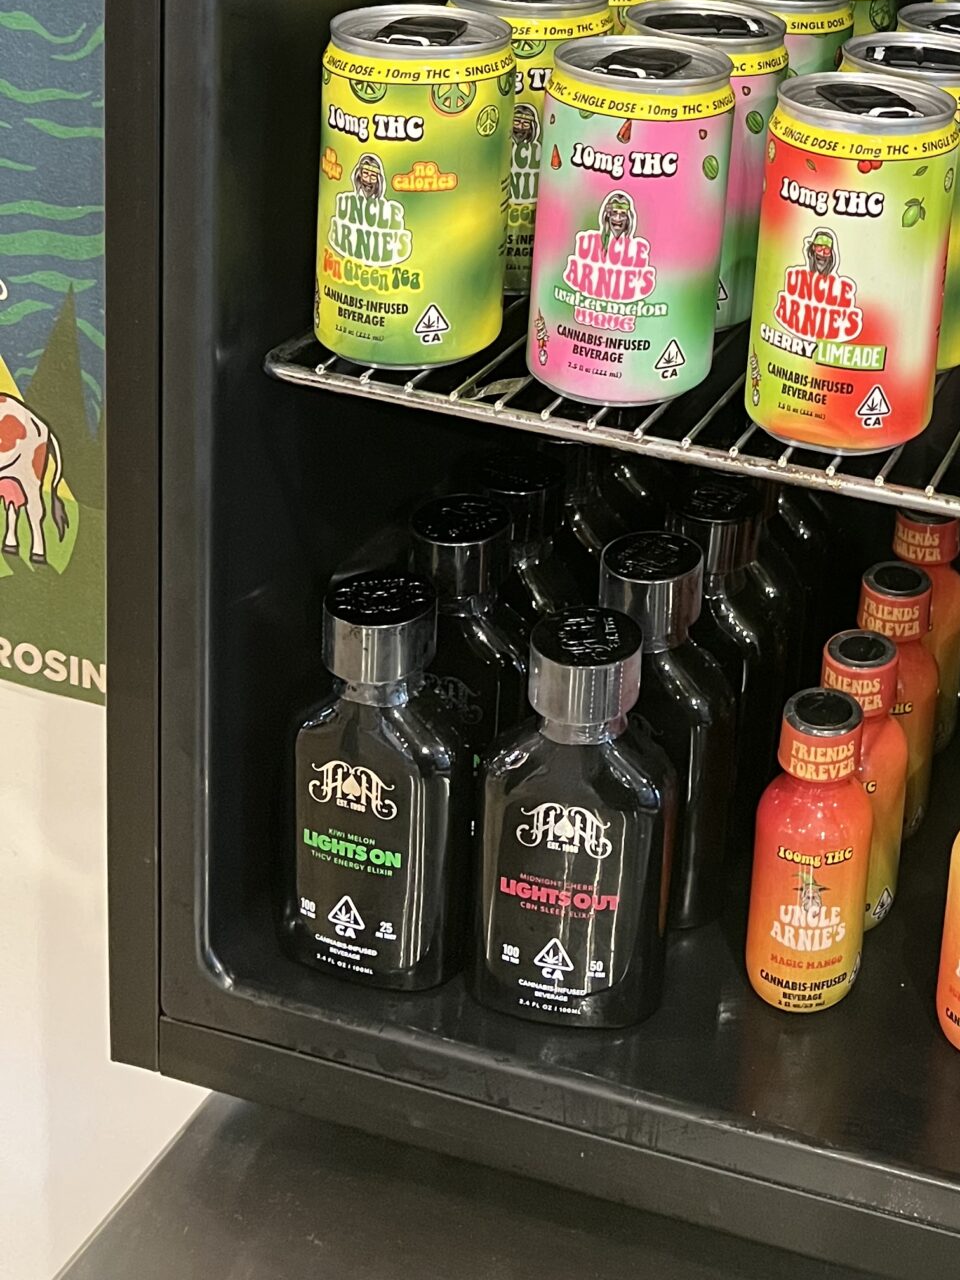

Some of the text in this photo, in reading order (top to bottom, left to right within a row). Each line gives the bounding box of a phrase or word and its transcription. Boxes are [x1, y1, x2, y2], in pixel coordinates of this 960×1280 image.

[385, 69, 450, 81] 10mg THC
[608, 101, 703, 118] DOSE 10mg THC
[328, 104, 424, 142] 10mg THC
[811, 137, 910, 157] DOSE 10mg THC
[414, 164, 434, 176] no
[571, 142, 678, 179] 10mg THC
[393, 174, 457, 191] calories
[780, 176, 885, 217] 10mg THC
[337, 194, 402, 229] UNCLE
[330, 218, 410, 262] ARNIE'S
[578, 233, 649, 267] UNCLE
[323, 247, 420, 291] Zen Green Tea
[566, 259, 654, 301] ARNIE'S
[787, 270, 853, 307] UNCLE
[554, 286, 668, 317] watermelon
[337, 306, 386, 327] BEVERAGE
[776, 295, 860, 339] ARNIE'S
[572, 344, 624, 363] BEVERAGE
[760, 323, 881, 368] CHERRY LIMEADE
[661, 368, 678, 379] CA
[781, 384, 827, 405] BEVERAGE
[863, 416, 881, 427] CA
[791, 740, 855, 763] FRIENDS
[789, 757, 855, 780] FOREVER
[303, 827, 402, 868] LIGHTS ON
[328, 828, 376, 845] KIWI MELON
[311, 850, 393, 876] THCV ENERGY ELIXIR
[778, 845, 853, 868] 100mg THC
[500, 877, 619, 911] LIGHTS OUT
[520, 901, 537, 911] CBN
[380, 921, 393, 933] 25
[770, 920, 846, 952] ARNIE'S
[590, 960, 603, 971] 50
